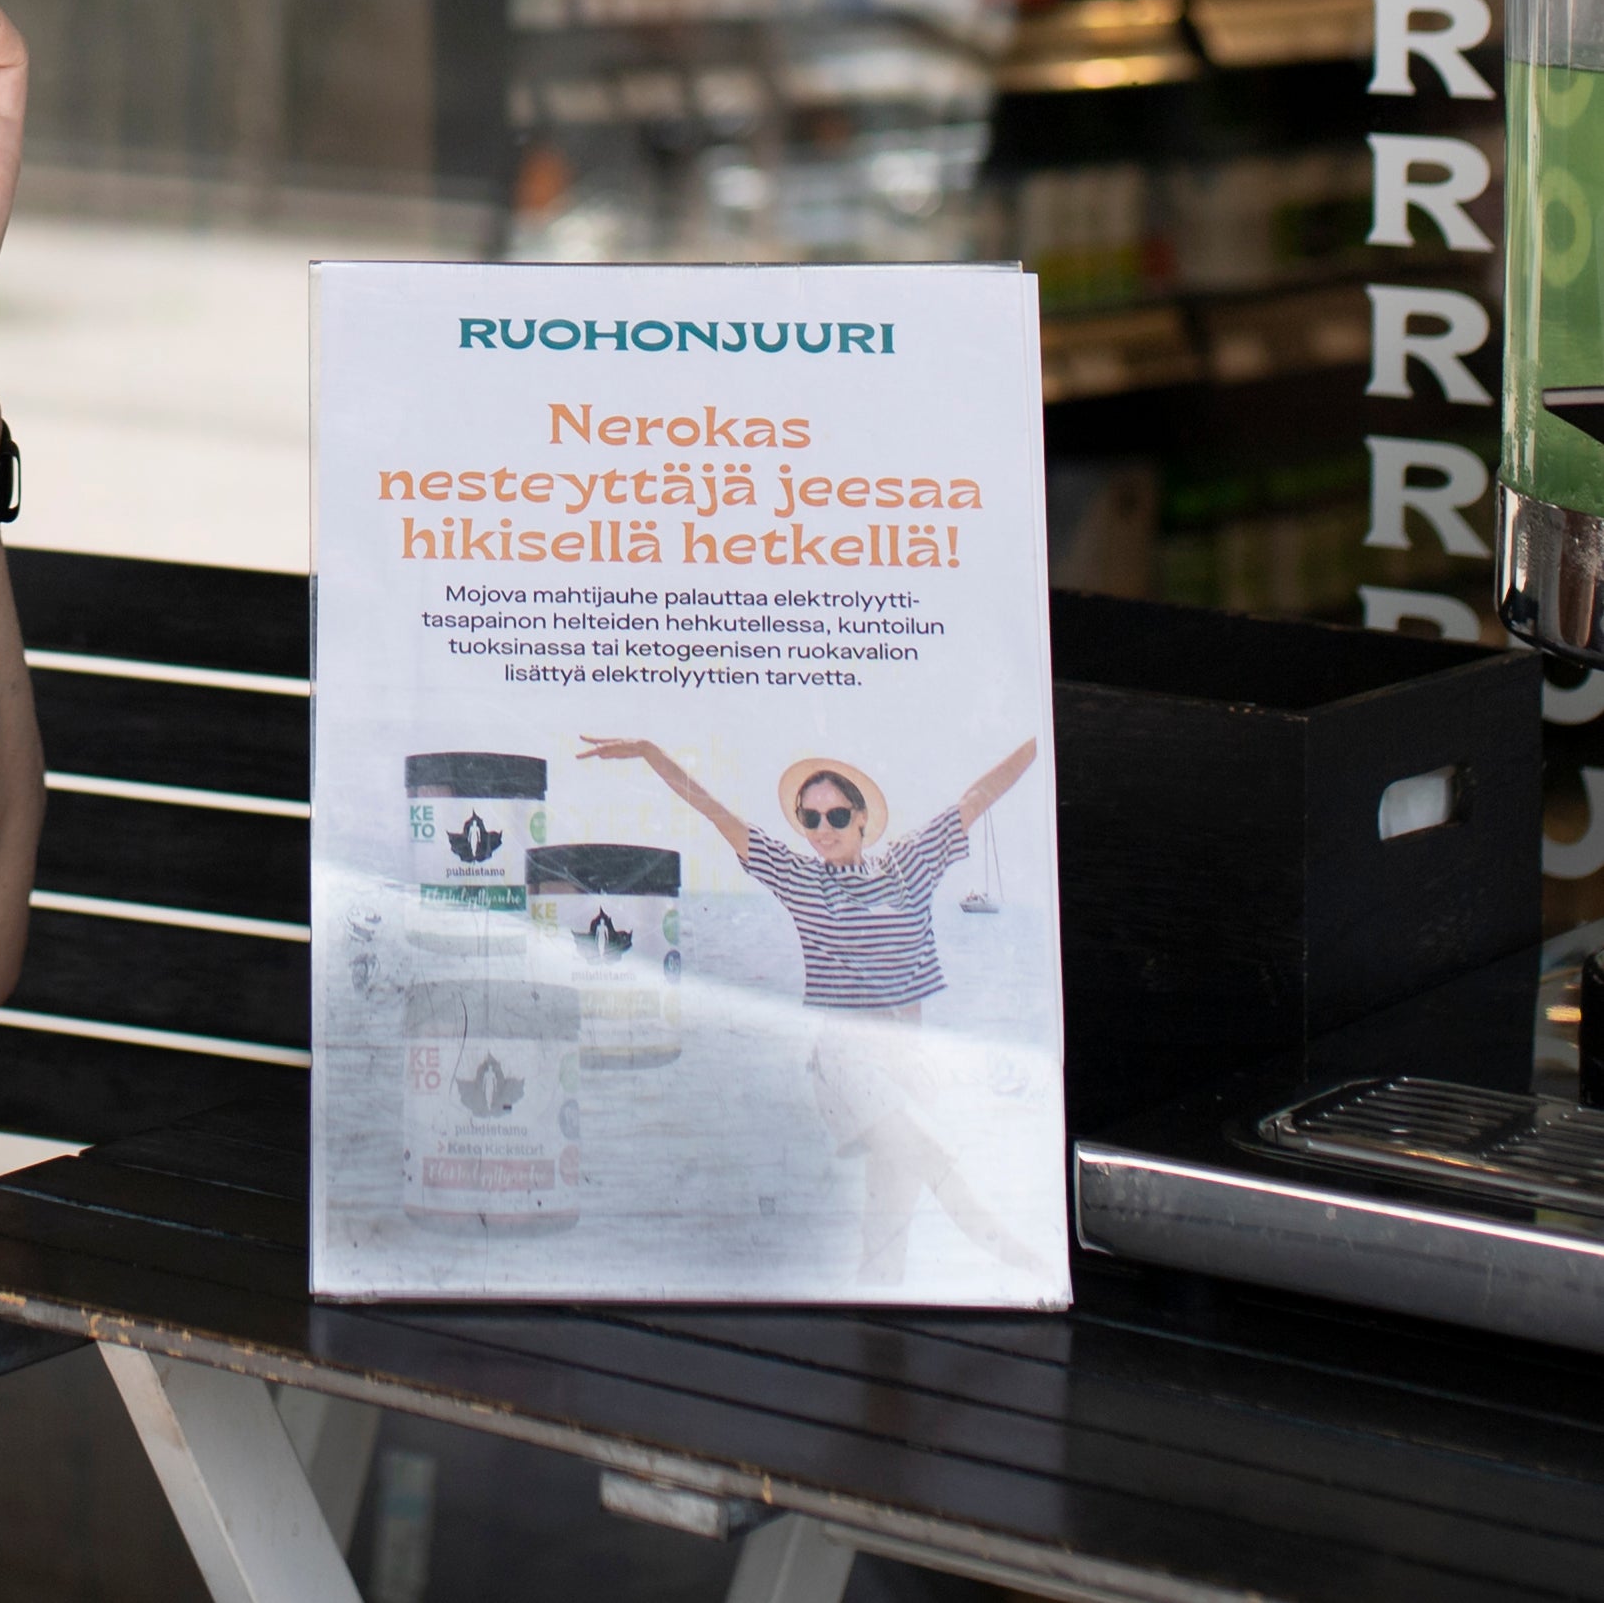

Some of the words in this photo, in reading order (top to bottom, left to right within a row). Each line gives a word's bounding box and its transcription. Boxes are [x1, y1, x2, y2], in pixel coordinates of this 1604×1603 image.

[459, 318, 895, 354] RUOHONJUURI
[548, 404, 811, 448] Nerokas
[379, 463, 757, 517] nesteyttäjä
[774, 464, 982, 518] jeesaa
[402, 517, 662, 563] hikisellä
[682, 522, 960, 568] hetkellä!
[446, 585, 526, 606] Mojova
[534, 586, 658, 608] mahtijauhe
[665, 588, 768, 610] palauttaa
[774, 589, 920, 613] elektrolyytti-
[421, 611, 546, 633] tasapainon
[554, 612, 659, 630] helteiden
[666, 614, 831, 636] hehkutellessa,
[839, 616, 944, 635] kuntoilun
[448, 638, 585, 656] tuoksinassa
[591, 638, 618, 656] tai
[626, 639, 781, 662] ketogeenisen
[788, 642, 918, 660] ruokavalion
[505, 664, 585, 687] lisättyä
[592, 665, 759, 688] elektrolyyttien
[765, 669, 862, 686] tarvetta.
[409, 806, 434, 820] KE
[410, 823, 435, 838] TO
[446, 866, 505, 878] puhdistamo
